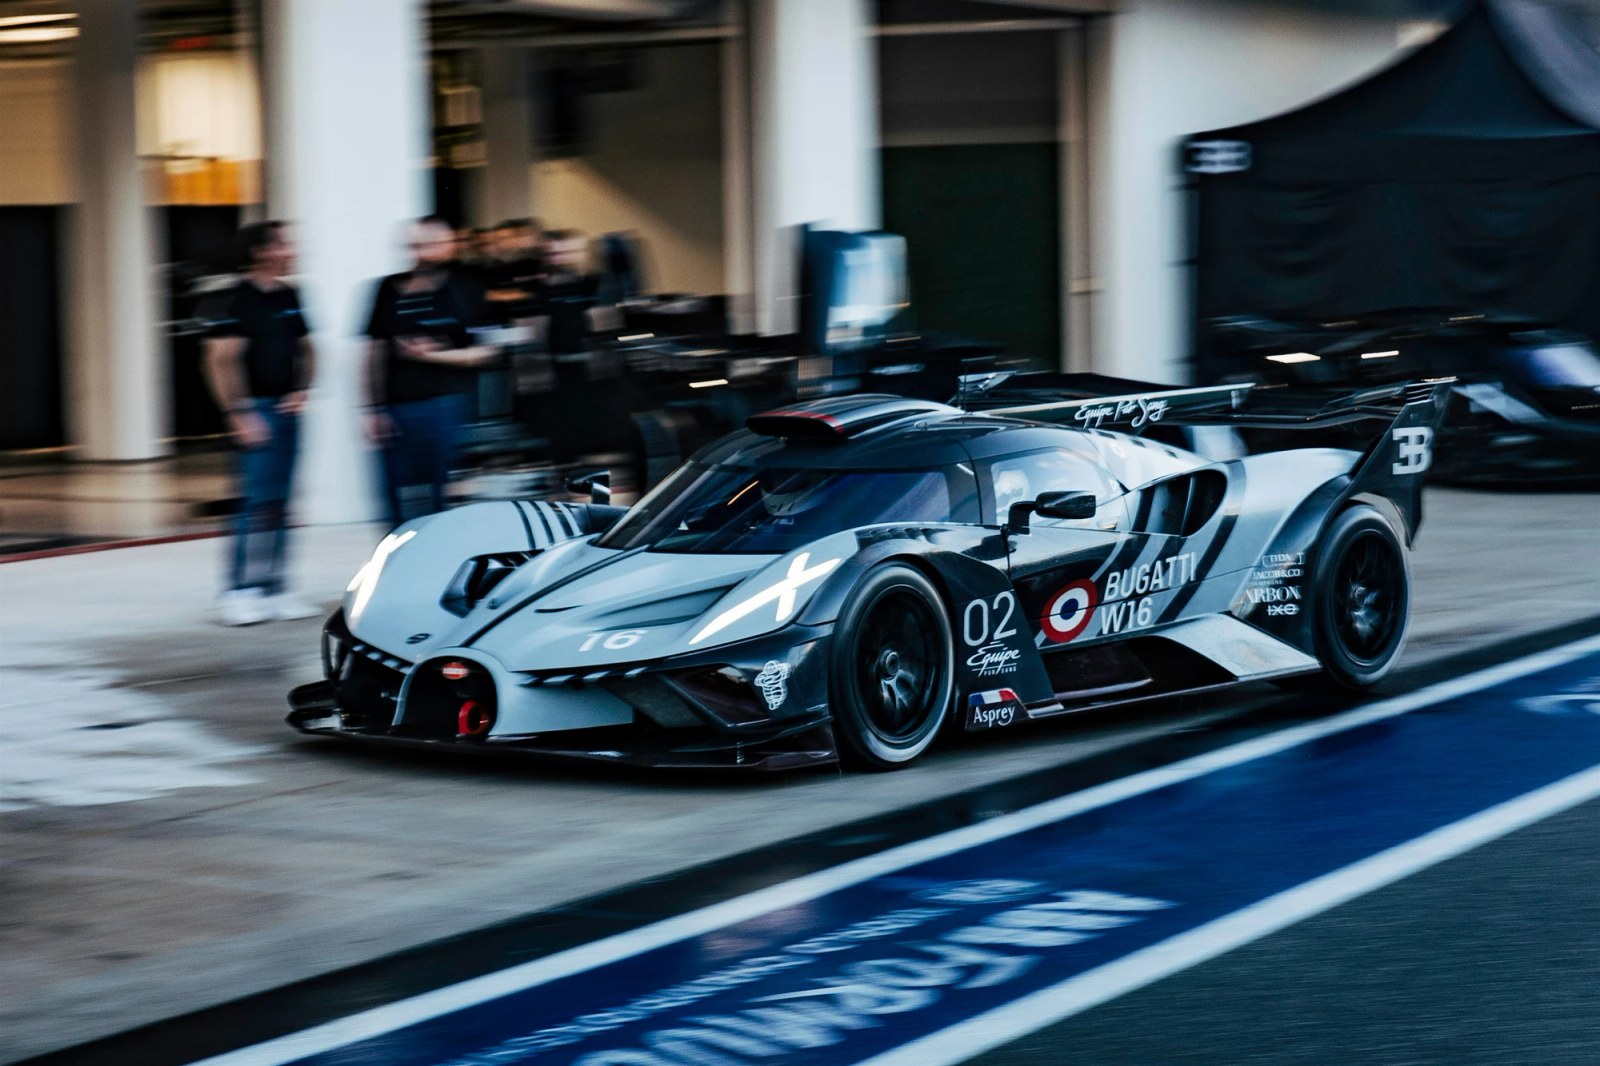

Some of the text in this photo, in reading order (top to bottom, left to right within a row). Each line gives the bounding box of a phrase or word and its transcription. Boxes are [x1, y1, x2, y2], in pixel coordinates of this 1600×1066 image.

[1103, 552, 1198, 602] BUGATTI
[963, 590, 1017, 646] 02
[1101, 597, 1153, 635] W16
[578, 629, 649, 652] 16
[973, 706, 1016, 728] Asprey
